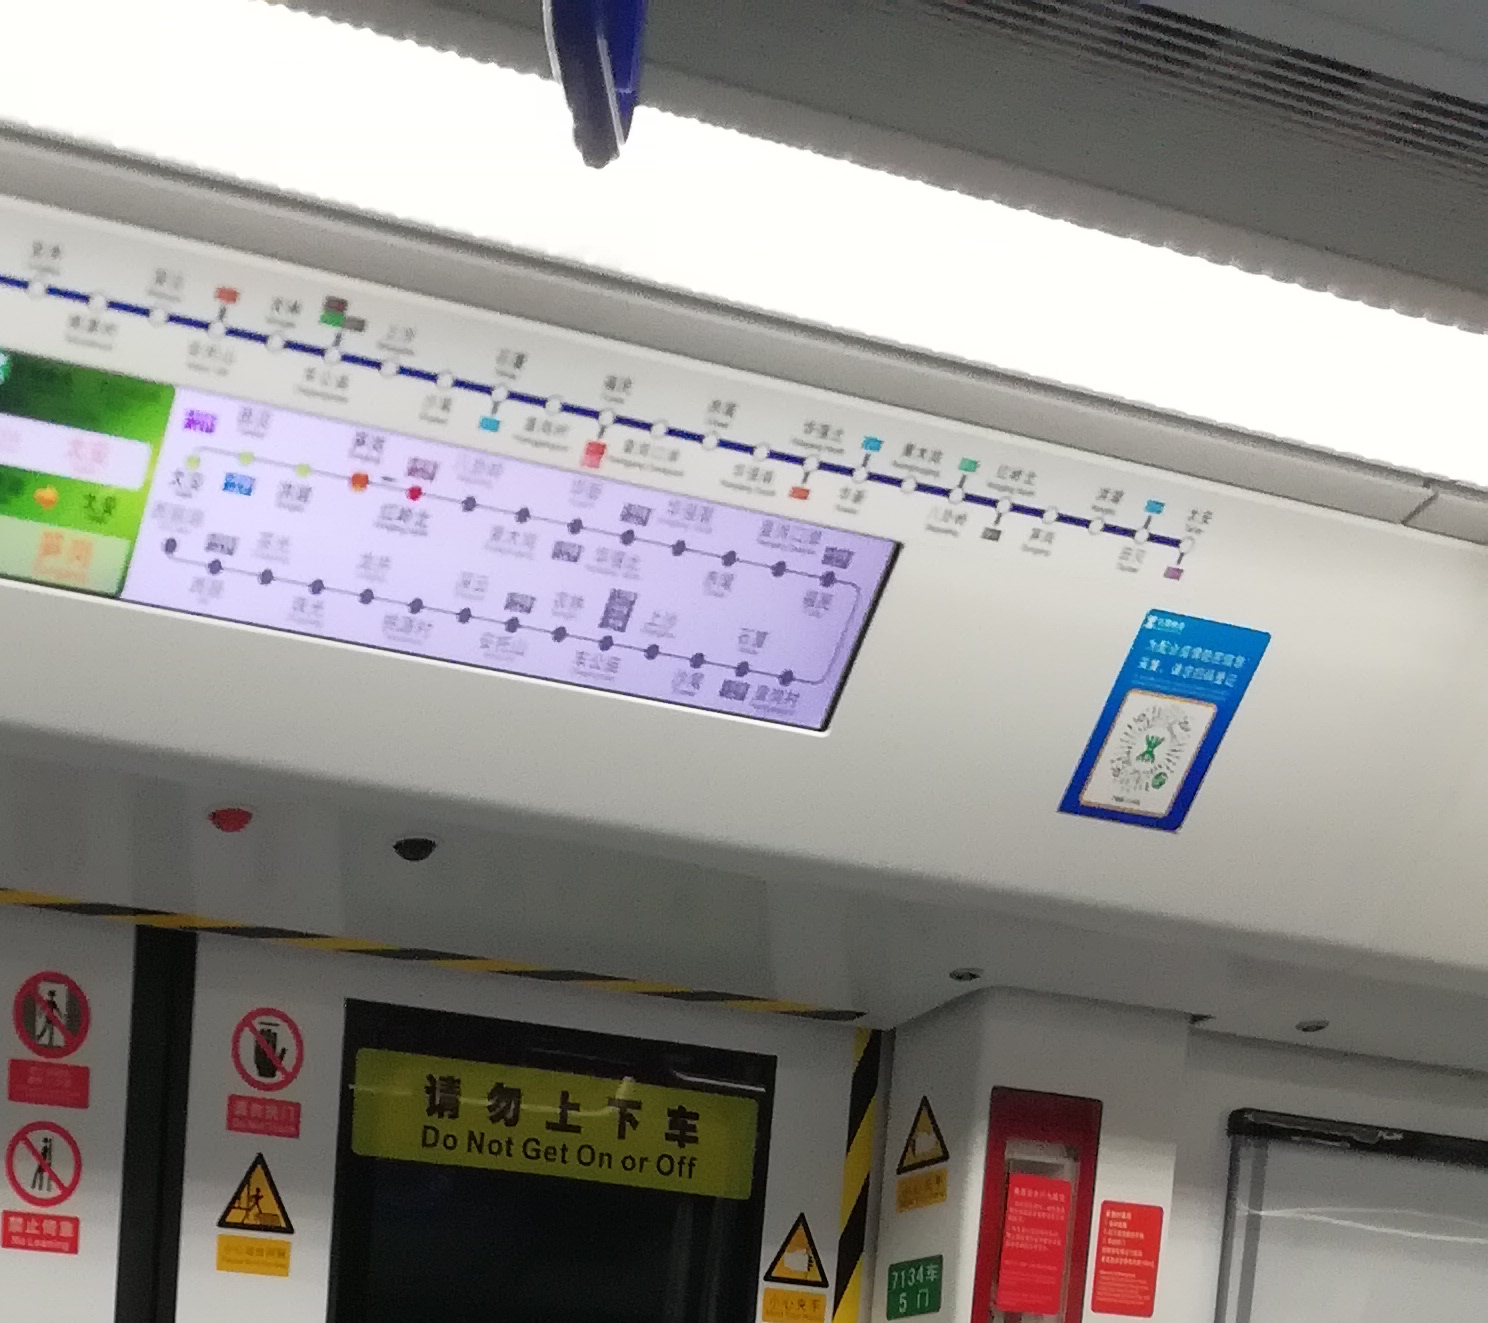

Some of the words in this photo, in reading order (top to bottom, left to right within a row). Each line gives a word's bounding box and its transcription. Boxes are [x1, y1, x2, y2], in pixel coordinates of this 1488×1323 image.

[423, 1073, 700, 1149] 请勿上下车
[421, 1125, 458, 1151] Do
[466, 1130, 514, 1158] Not
[521, 1137, 569, 1165] Get
[576, 1144, 613, 1170] On
[620, 1154, 649, 1174] or
[655, 1153, 699, 1179] Off
[891, 1263, 940, 1291] 7134车
